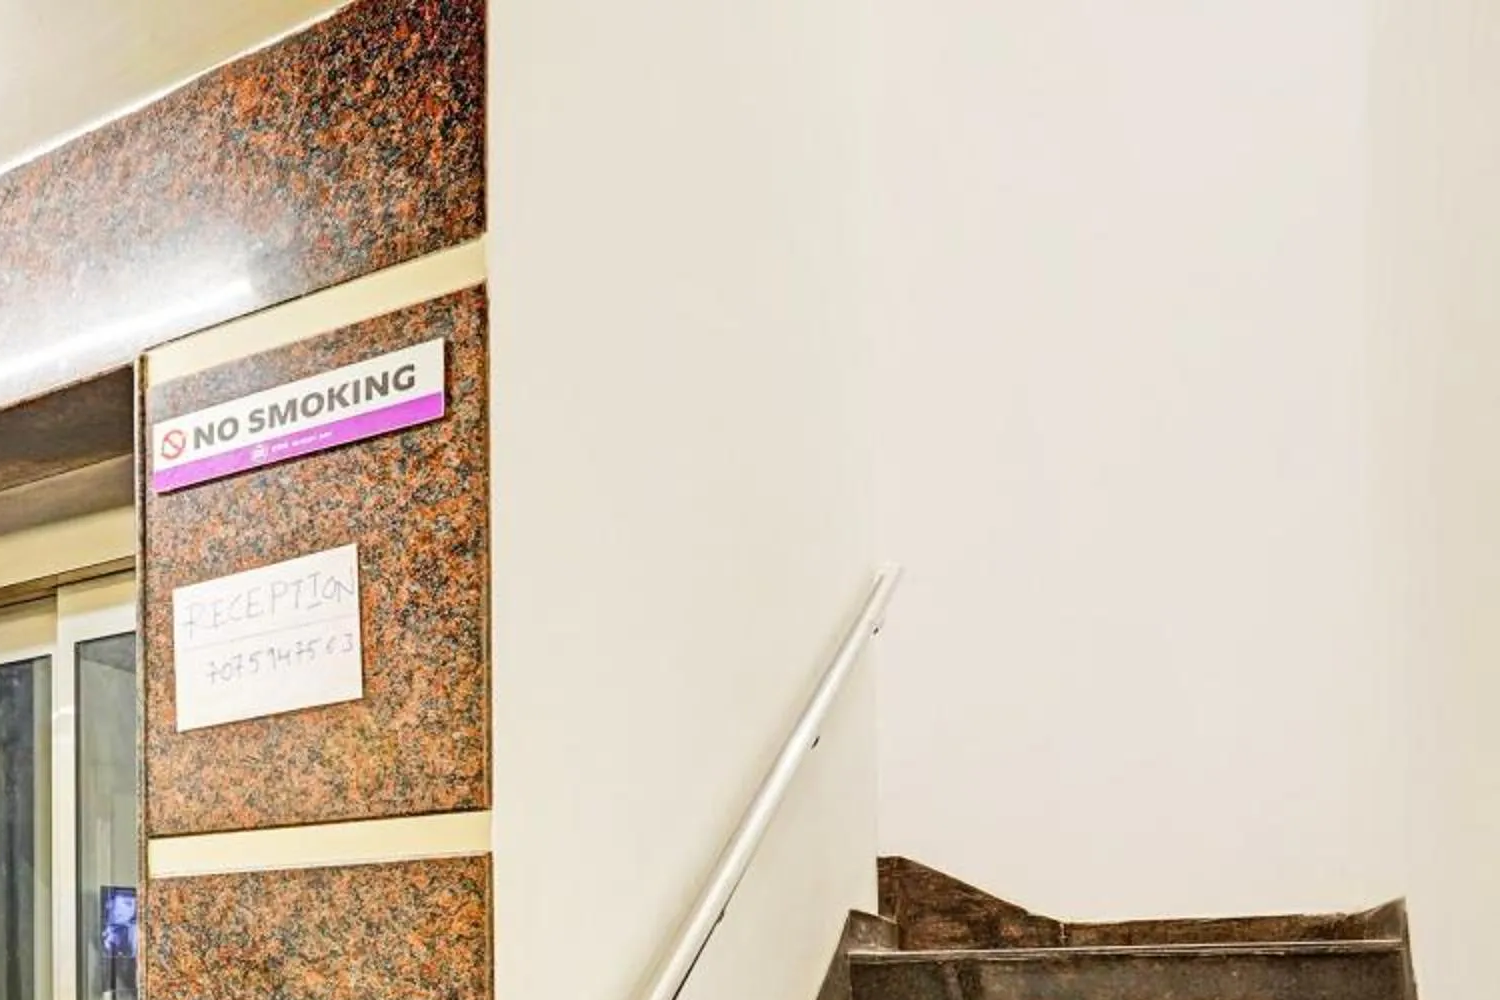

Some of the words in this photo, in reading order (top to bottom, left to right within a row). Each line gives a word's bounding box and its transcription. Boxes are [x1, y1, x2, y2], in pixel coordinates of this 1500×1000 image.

[193, 416, 240, 451] NO
[248, 364, 417, 434] SMOKING
[184, 566, 356, 640] RECEPTION
